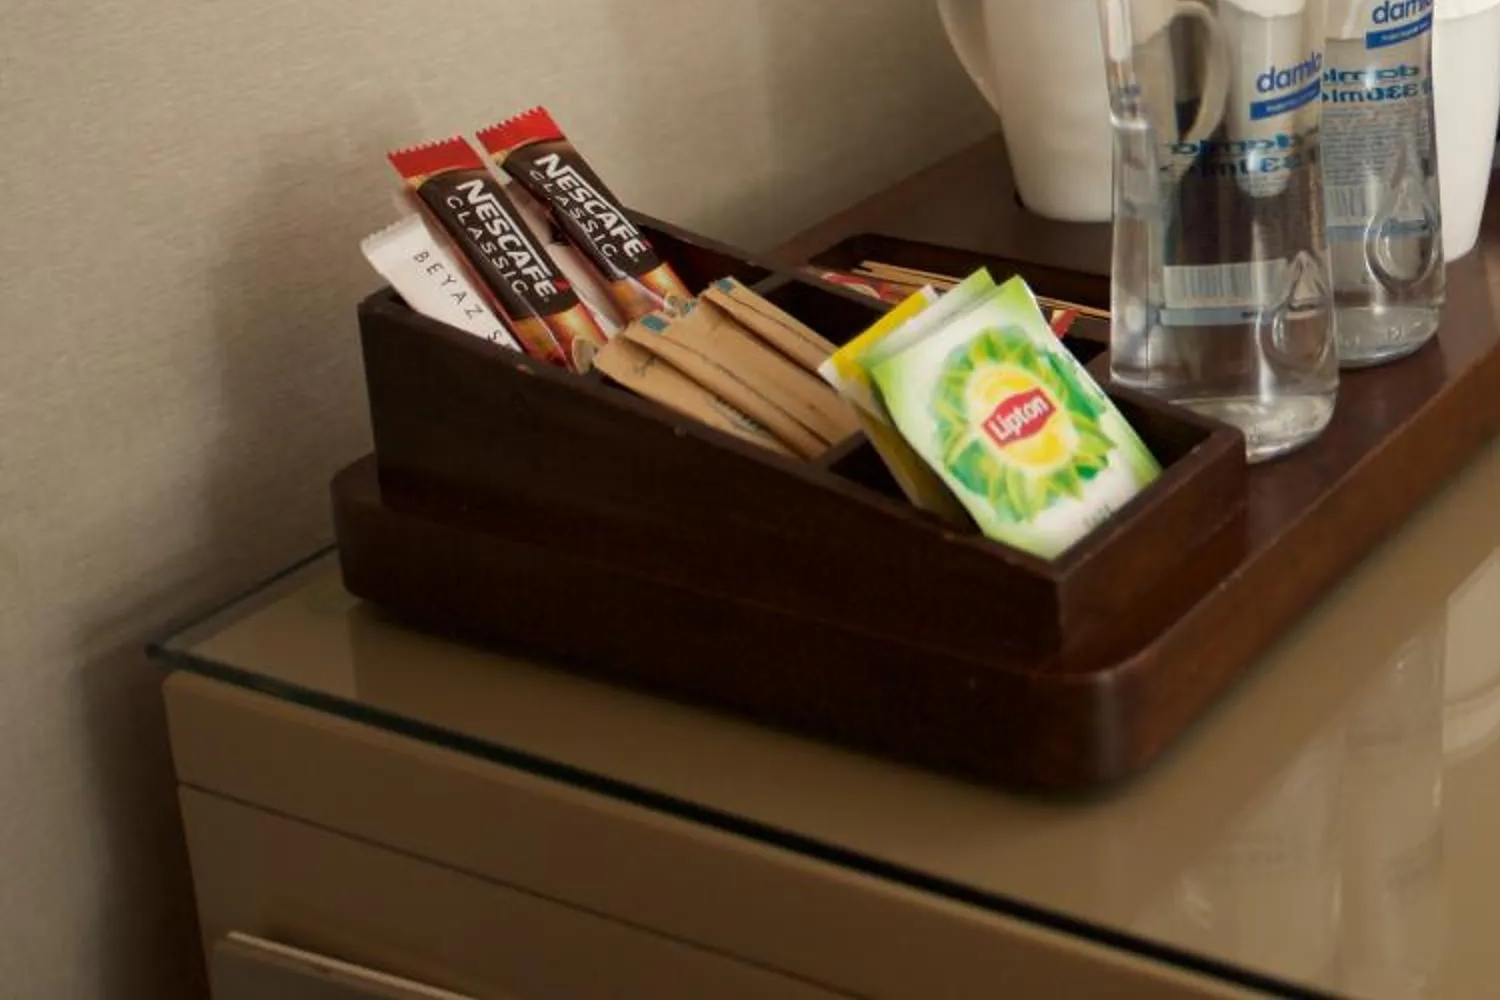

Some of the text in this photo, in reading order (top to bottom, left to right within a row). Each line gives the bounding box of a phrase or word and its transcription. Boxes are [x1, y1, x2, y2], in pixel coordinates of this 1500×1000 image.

[446, 195, 529, 294] CLASSIC
[529, 169, 618, 258] CLASSIC
[413, 250, 484, 321] BEYAZ
[985, 395, 1051, 441] Lipton
